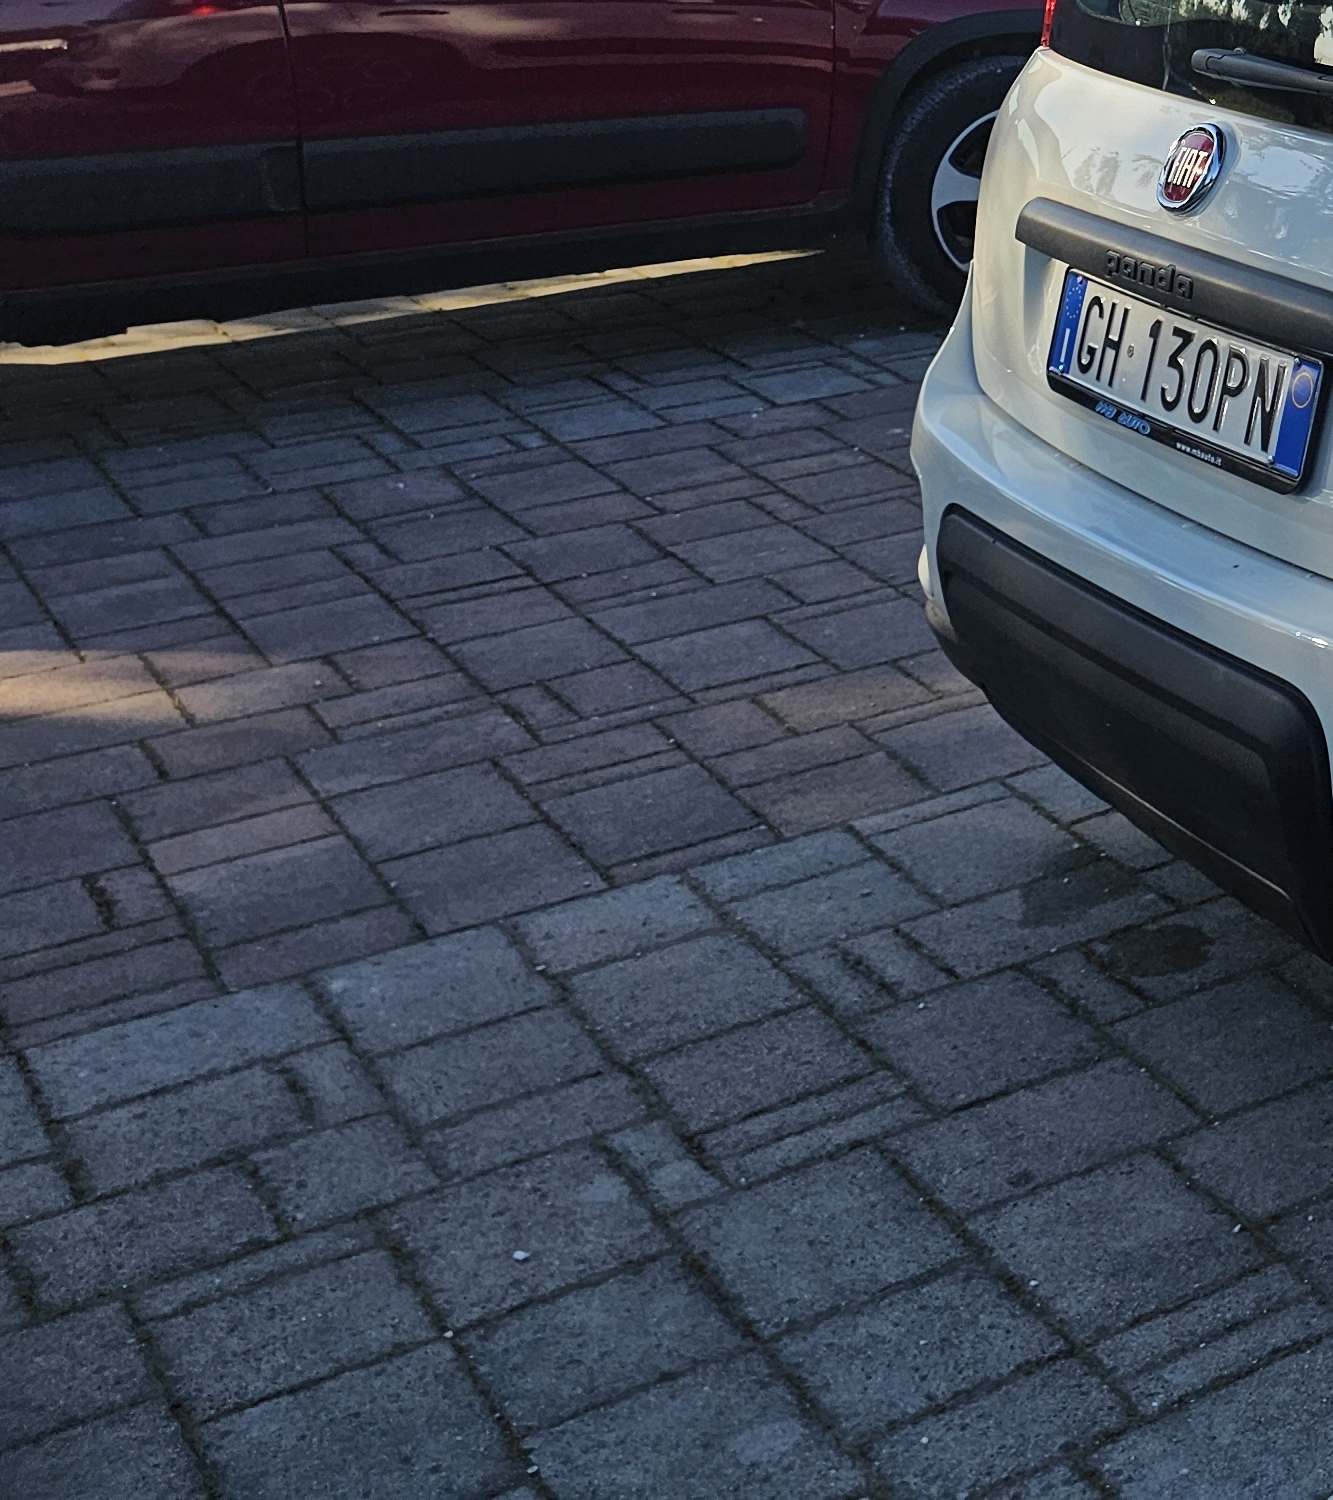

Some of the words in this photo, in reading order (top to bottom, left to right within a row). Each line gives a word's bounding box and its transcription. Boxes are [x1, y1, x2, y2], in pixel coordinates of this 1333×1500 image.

[1167, 146, 1210, 189] FIAT
[1103, 249, 1195, 302] panda
[1076, 294, 1132, 389] GH
[1140, 314, 1288, 453] 130PN
[1117, 411, 1151, 436] AUTO
